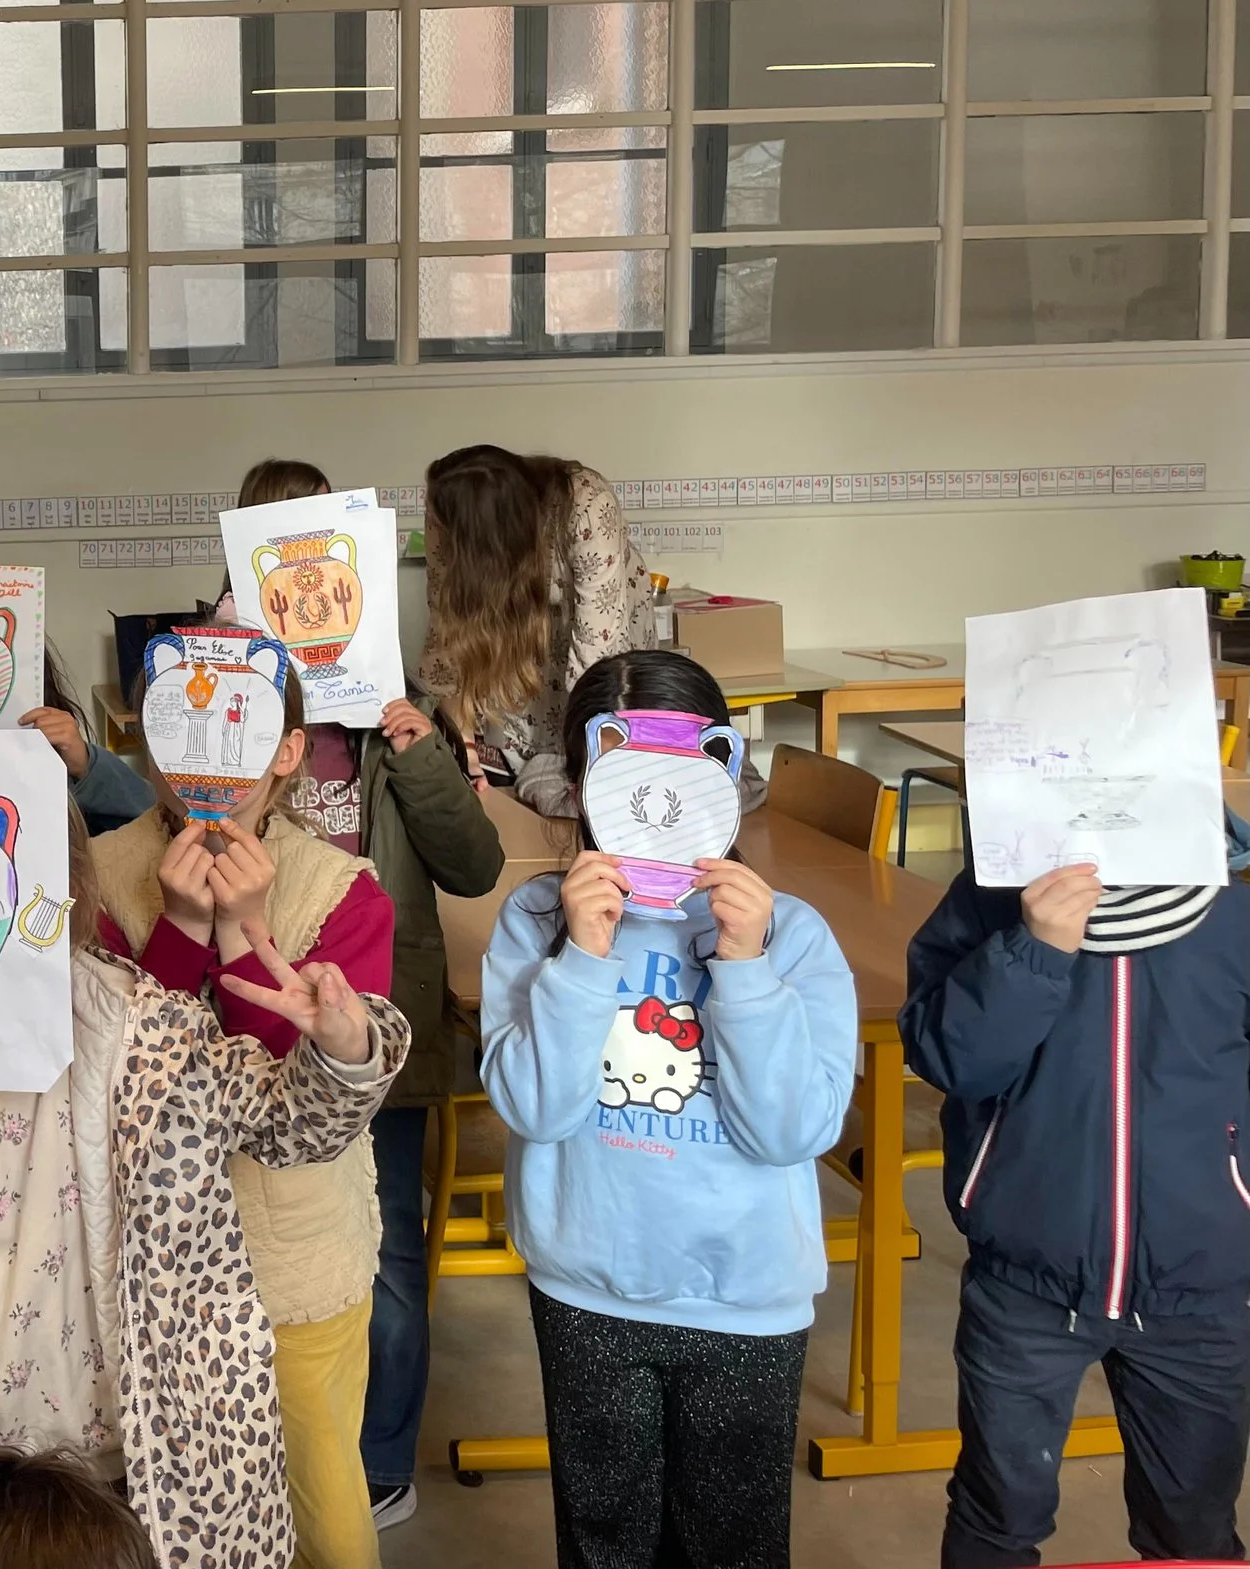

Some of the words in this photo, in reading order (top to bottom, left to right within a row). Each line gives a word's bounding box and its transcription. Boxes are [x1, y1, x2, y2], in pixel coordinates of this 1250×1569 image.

[626, 484, 640, 494] 39
[646, 484, 660, 493] 40
[665, 483, 679, 493] 41
[683, 483, 698, 492] 42
[702, 482, 717, 491] 43
[720, 481, 735, 491] 44
[740, 481, 755, 490] 45
[759, 480, 774, 490] 46
[777, 480, 792, 489] 47
[796, 479, 810, 489] 48
[814, 478, 829, 487] 49
[835, 478, 850, 488] 50
[854, 477, 868, 487] 51
[873, 476, 887, 486] 52
[891, 476, 905, 486] 53
[909, 475, 924, 485] 54
[929, 474, 943, 484] 55
[948, 474, 962, 484] 56
[967, 474, 981, 483] 57
[985, 474, 999, 483] 58
[1004, 473, 1018, 483] 59
[1022, 472, 1037, 481] 60
[1041, 472, 1055, 481] 61
[1059, 471, 1074, 481] 62
[1078, 471, 1092, 480] 63
[1096, 469, 1110, 478] 64
[1115, 469, 1131, 478] 65
[1135, 468, 1150, 478] 66
[1154, 468, 1167, 478] 67
[1171, 467, 1185, 477] 68
[1189, 467, 1203, 477] 69
[8, 503, 15, 512] 6
[27, 502, 34, 512] 7
[45, 501, 52, 511] 8
[64, 501, 71, 511] 9
[81, 501, 94, 510] 10
[100, 500, 112, 510] 11
[118, 499, 131, 509] 12
[137, 498, 150, 508] 13
[155, 497, 168, 507] 14
[175, 497, 189, 507] 15
[194, 496, 207, 506] 16
[212, 496, 225, 506] 17
[231, 495, 236, 505] 1
[382, 490, 397, 500] 26
[400, 490, 414, 500] 27
[419, 489, 426, 499] 2
[643, 527, 660, 536] 100
[663, 527, 679, 536] 101
[684, 527, 700, 536] 102
[705, 526, 721, 536] 103
[82, 544, 96, 553] 70
[101, 543, 114, 553] 71
[120, 543, 133, 552] 72
[138, 542, 151, 552] 73
[156, 542, 169, 551] 74
[174, 541, 188, 550] 75
[193, 540, 207, 550] 76
[315, 680, 379, 700] Tania
[585, 1105, 732, 1145] ENTURE
[598, 1131, 635, 1150] Hello
[637, 1139, 676, 1160] Kitty
